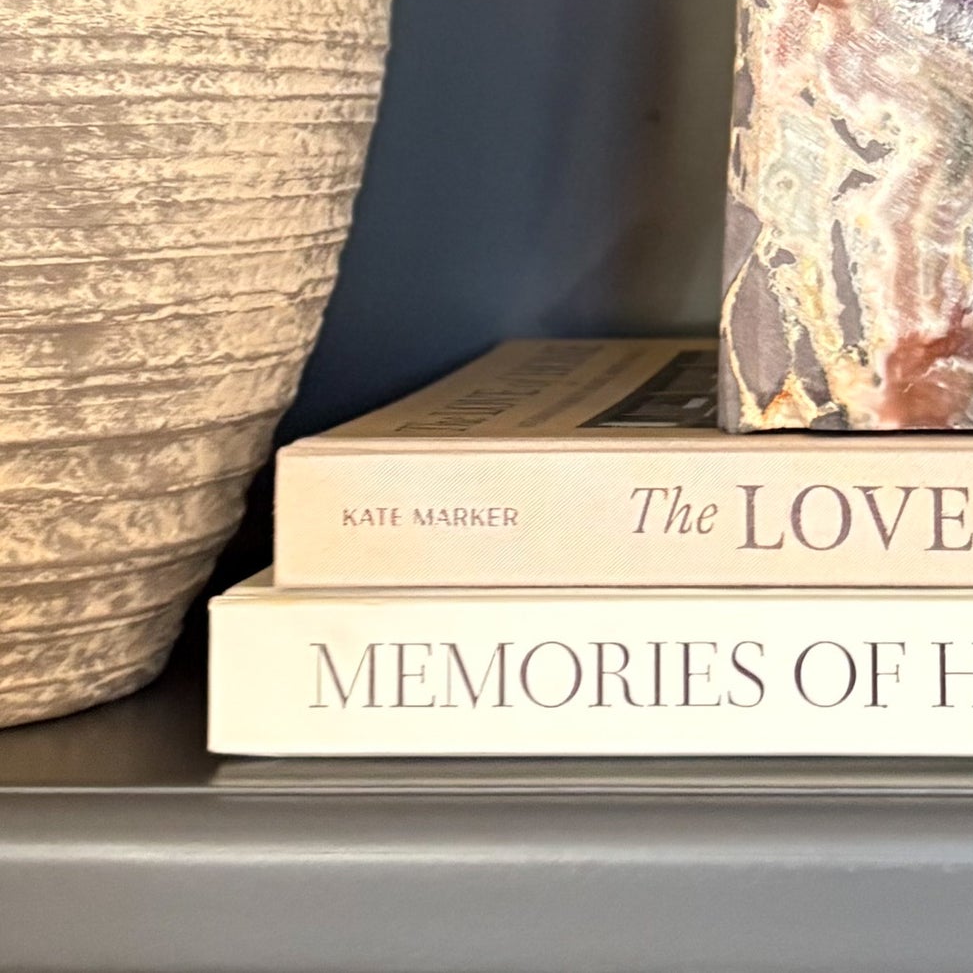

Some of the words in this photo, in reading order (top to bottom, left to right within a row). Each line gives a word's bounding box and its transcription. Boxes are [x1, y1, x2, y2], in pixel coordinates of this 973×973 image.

[343, 507, 402, 527] KATE
[413, 507, 519, 527] MARKER
[630, 485, 719, 535] The
[735, 484, 973, 552] LOVE
[308, 640, 765, 709] MEMORIES
[794, 640, 906, 709] OF
